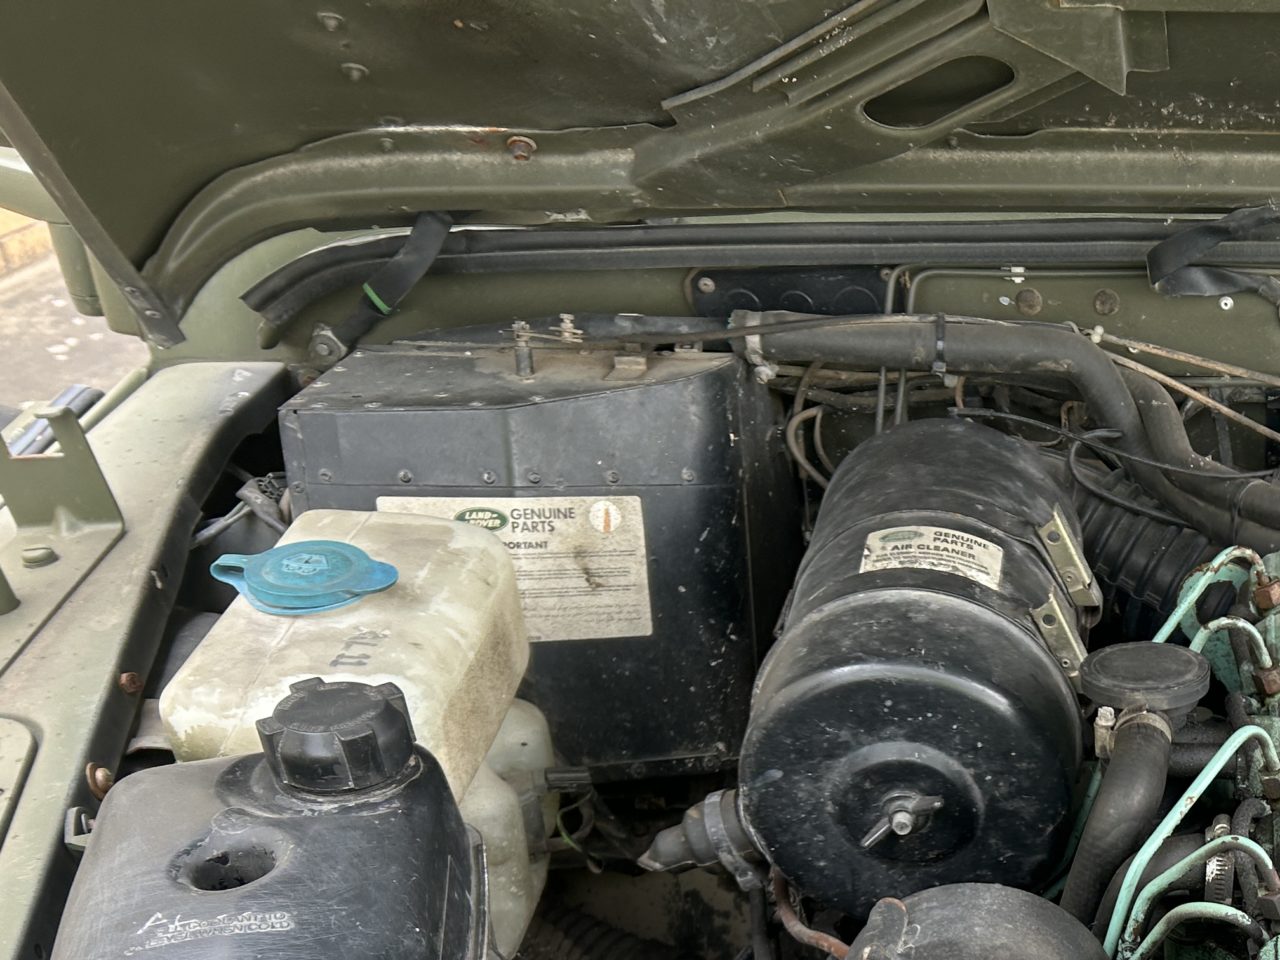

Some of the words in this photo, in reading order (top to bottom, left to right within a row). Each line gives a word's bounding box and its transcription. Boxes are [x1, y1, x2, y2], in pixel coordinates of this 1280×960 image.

[510, 507, 576, 521] GENUINE
[511, 520, 555, 533] PARTS
[932, 537, 974, 551] PARTS
[933, 530, 990, 550] GENUINE
[890, 543, 913, 552] AIR
[916, 543, 976, 561] CLEANER
